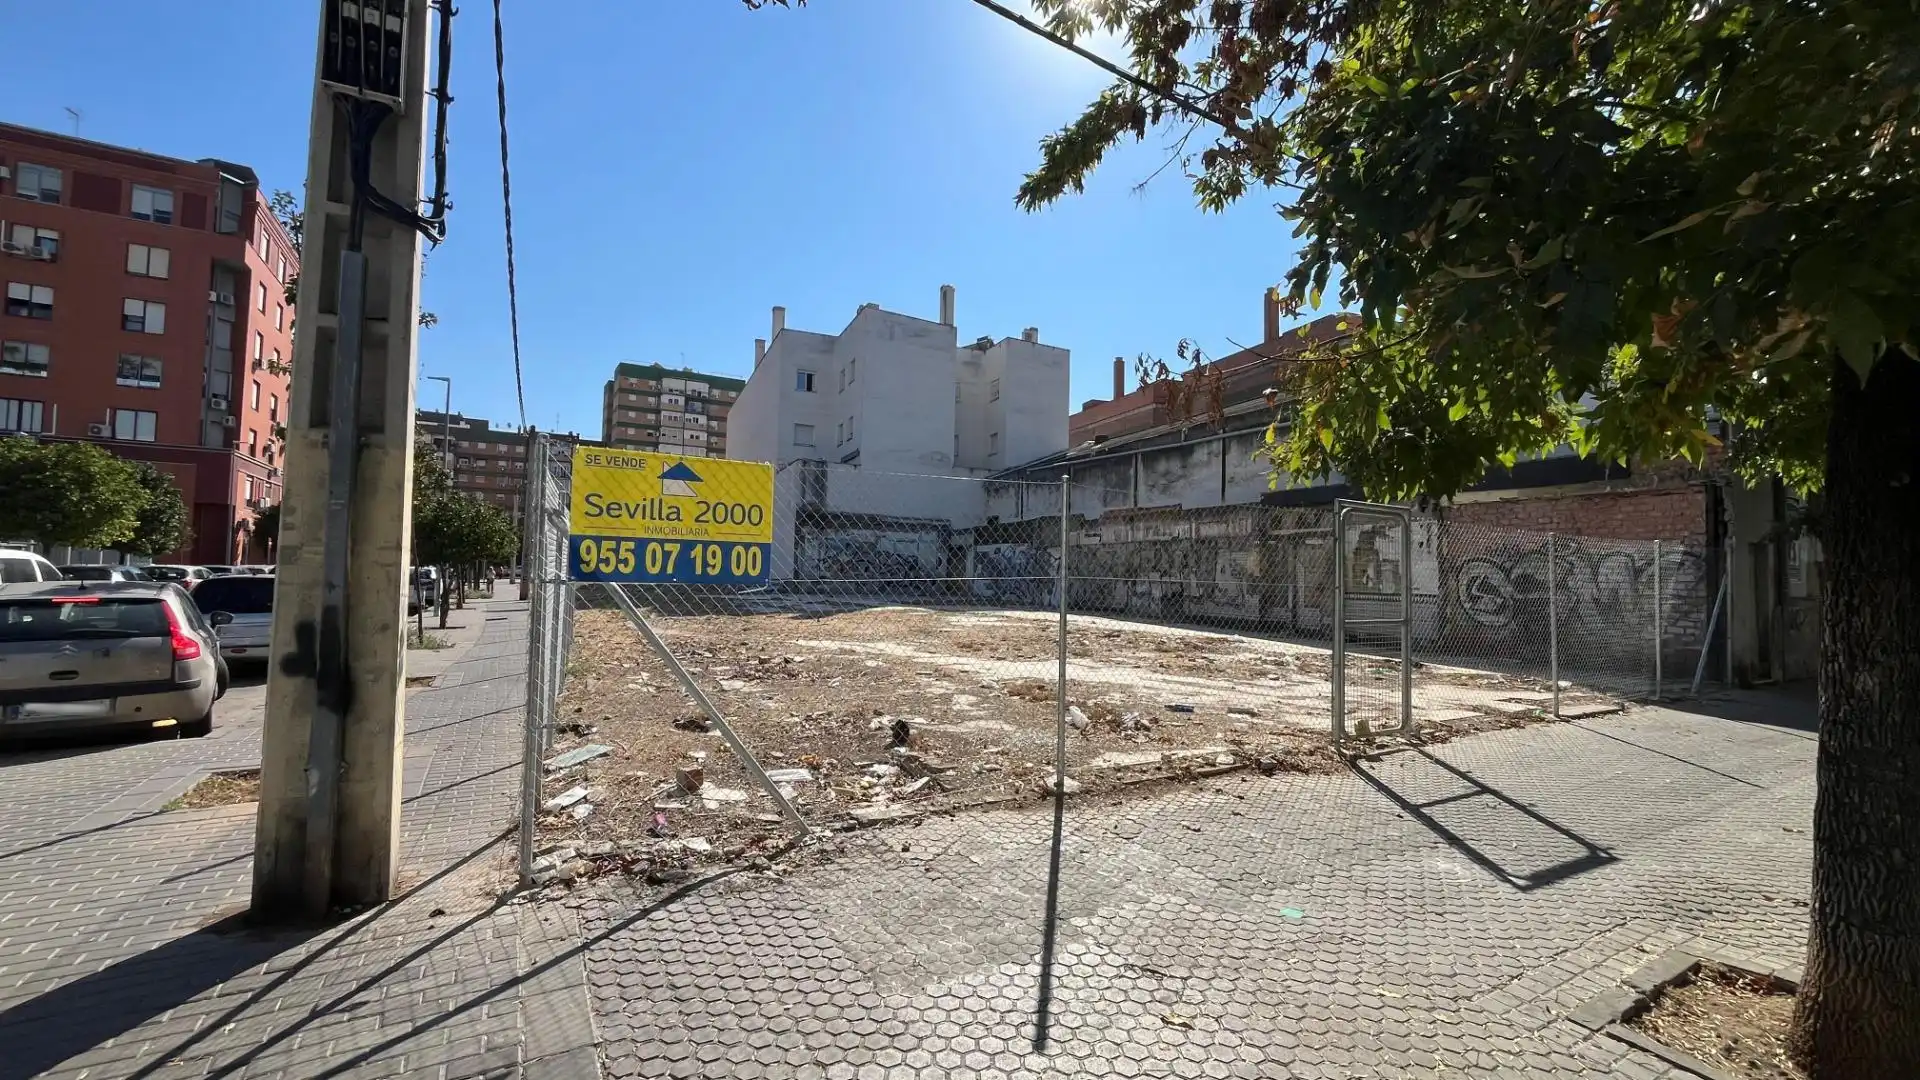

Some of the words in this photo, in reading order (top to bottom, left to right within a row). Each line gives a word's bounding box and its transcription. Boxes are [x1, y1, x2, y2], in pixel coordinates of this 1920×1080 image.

[585, 453, 601, 465] SE
[606, 456, 646, 469] VENDE
[584, 492, 683, 522] Sevilla
[694, 500, 763, 526] 2000
[643, 525, 709, 537] INMOBILIARIA
[579, 539, 636, 574] 955
[645, 542, 681, 575] 07
[690, 543, 722, 576] 19
[731, 545, 762, 577] 00
